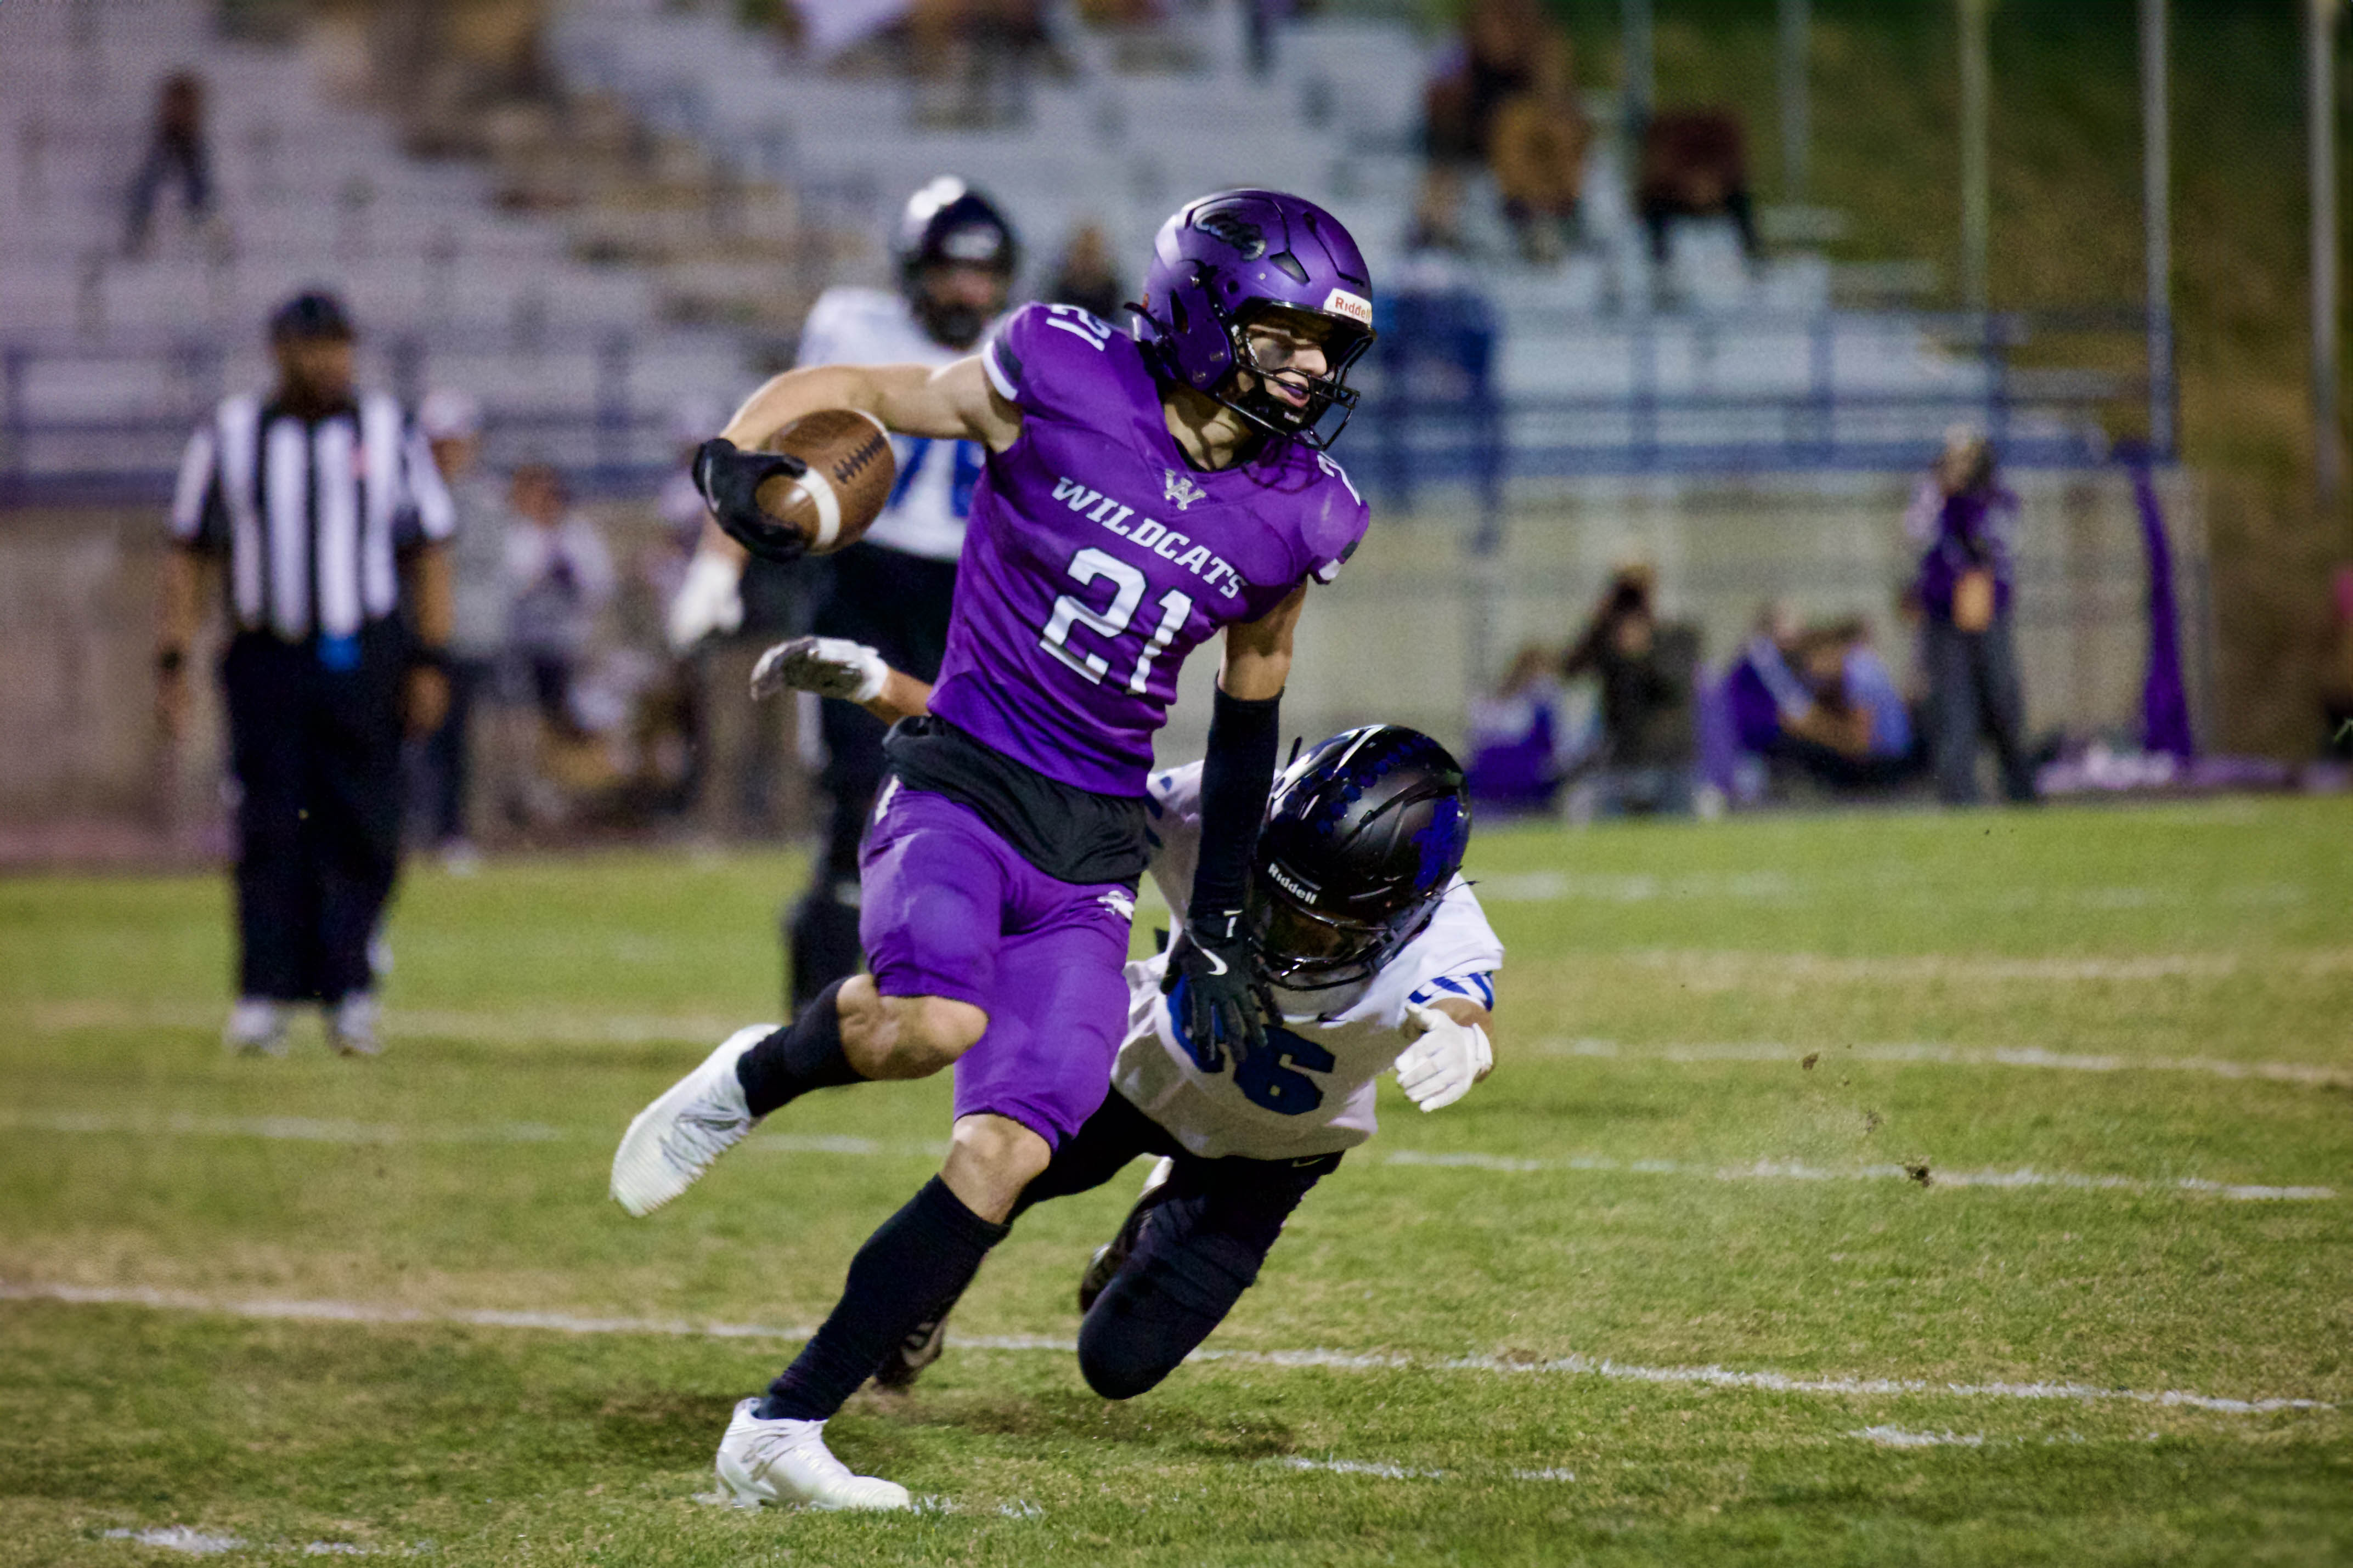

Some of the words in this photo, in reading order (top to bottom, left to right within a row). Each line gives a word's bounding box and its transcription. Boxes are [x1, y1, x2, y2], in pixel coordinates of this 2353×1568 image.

[1045, 303, 1111, 352] 21
[1334, 296, 1372, 321] Riddell
[1051, 476, 1248, 598] WILDCATS
[1040, 547, 1193, 694] 21
[1267, 862, 1318, 905] Riddell
